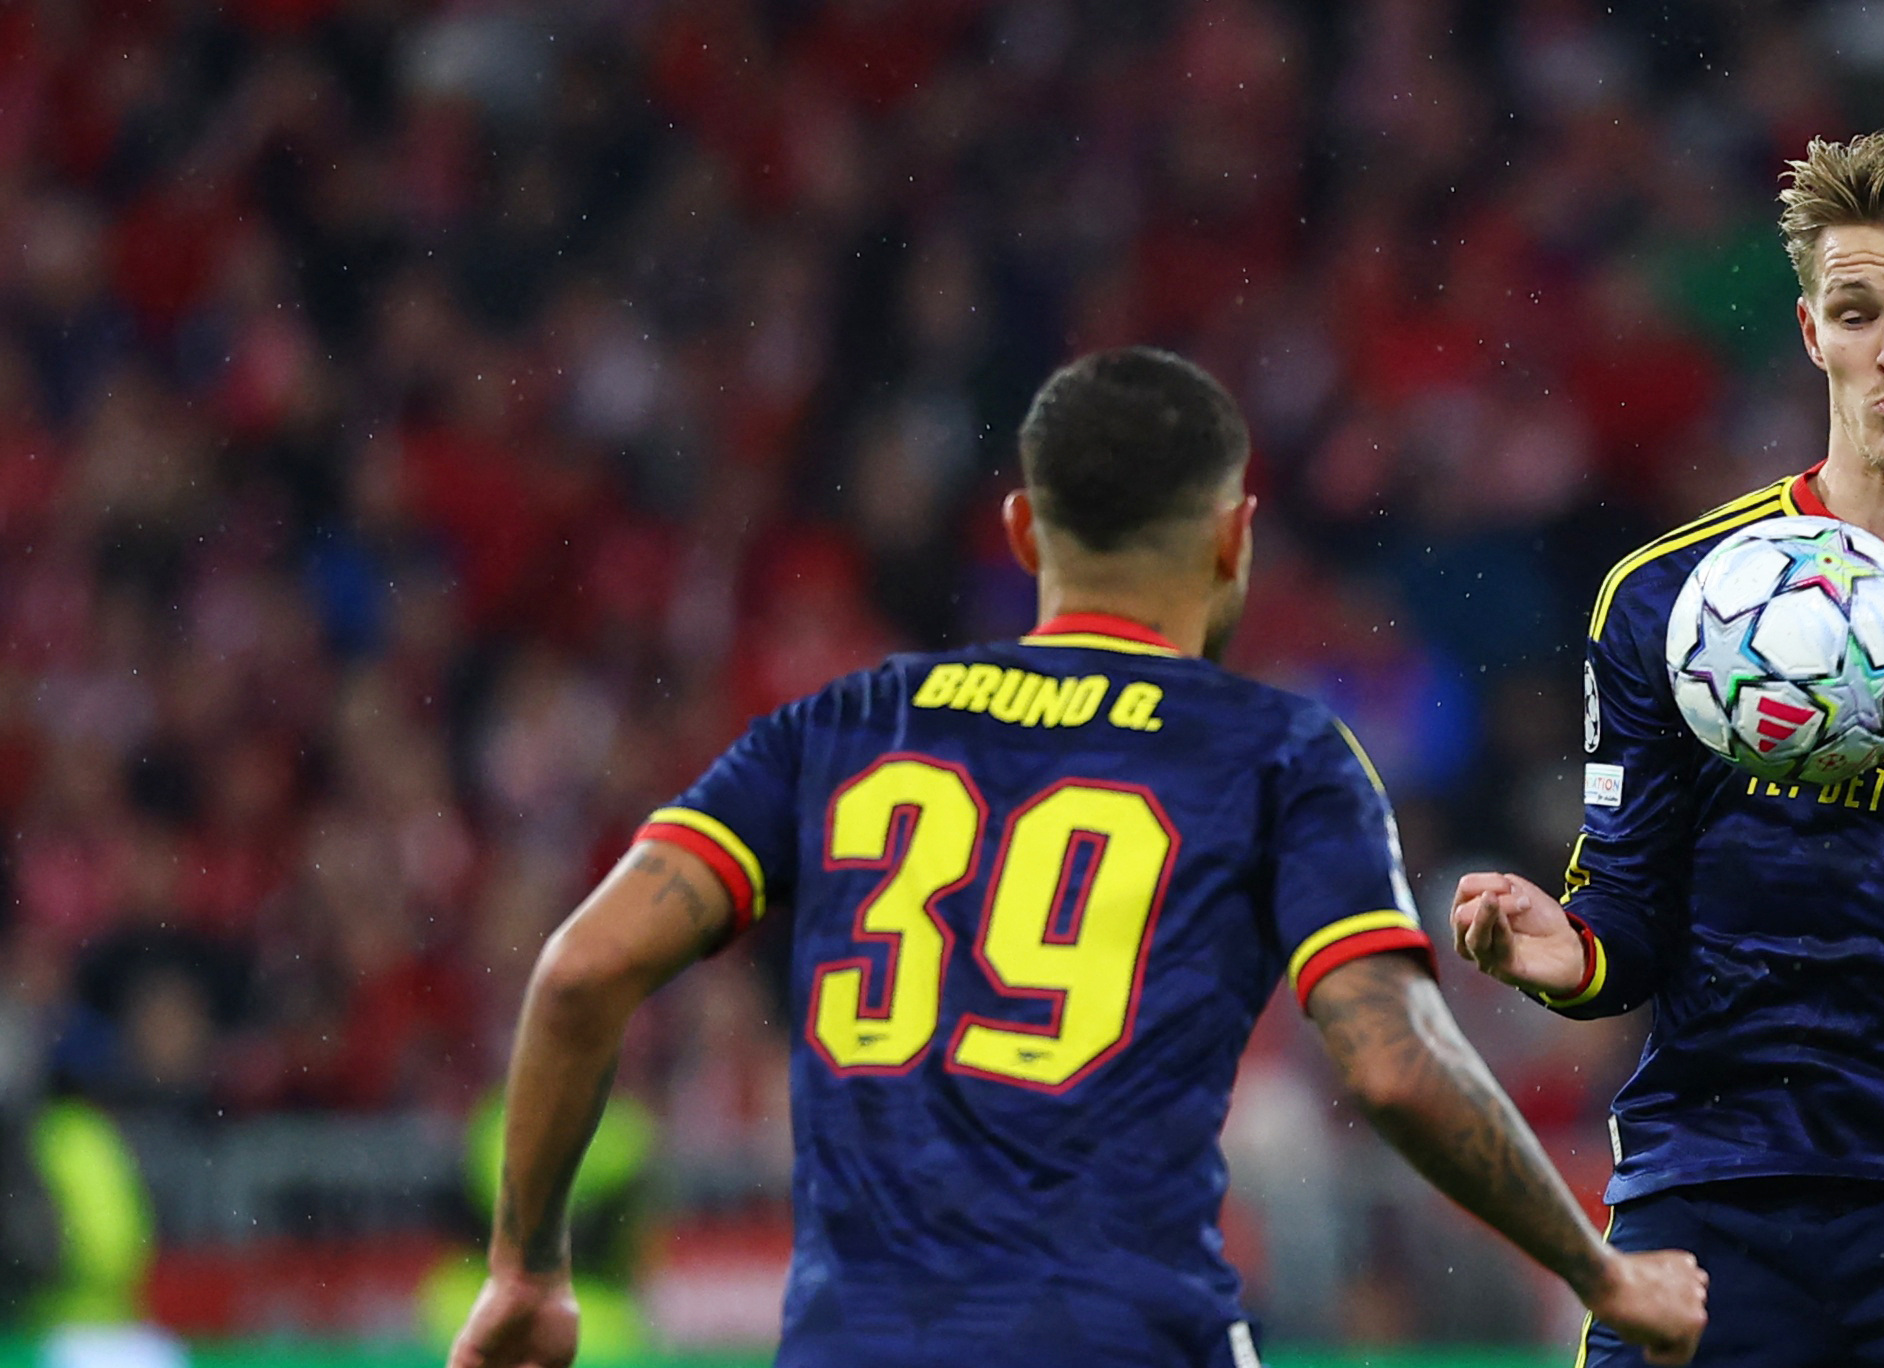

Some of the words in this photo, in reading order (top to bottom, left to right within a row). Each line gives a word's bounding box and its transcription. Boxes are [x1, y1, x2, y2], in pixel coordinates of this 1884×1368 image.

[912, 662, 1110, 729] BRUNO
[1107, 680, 1164, 732] G.
[806, 751, 1182, 1094] 39
